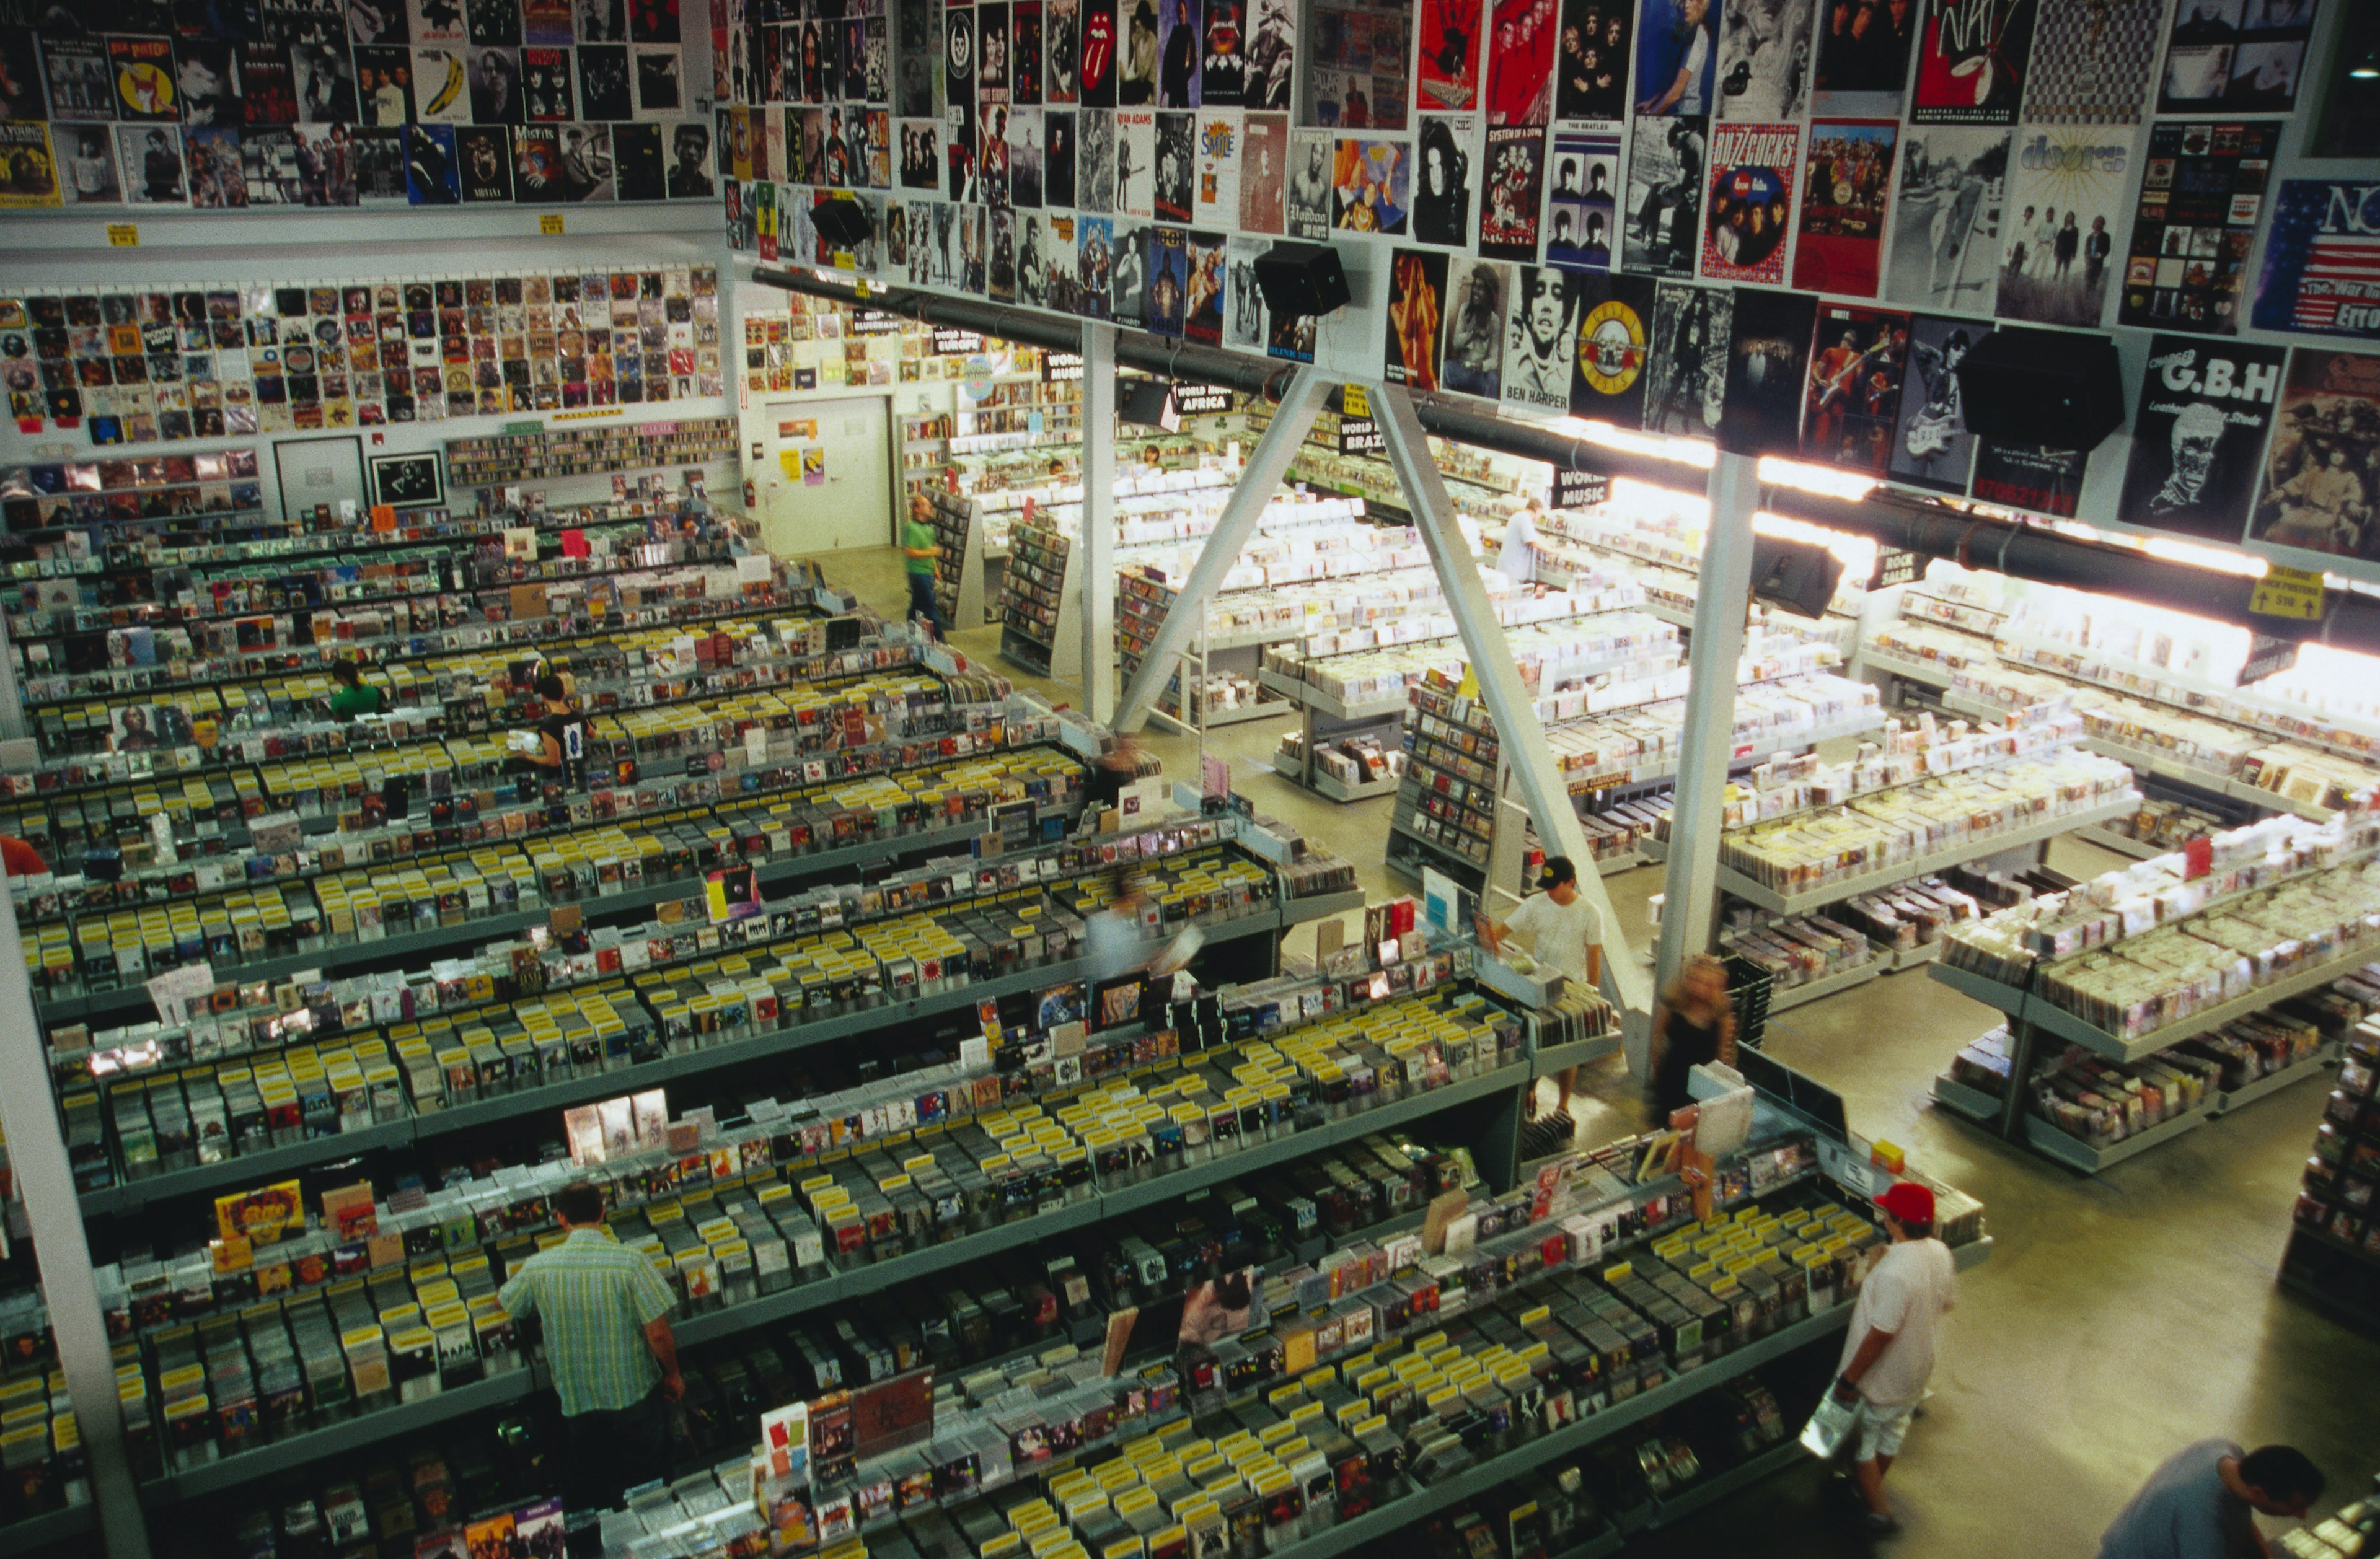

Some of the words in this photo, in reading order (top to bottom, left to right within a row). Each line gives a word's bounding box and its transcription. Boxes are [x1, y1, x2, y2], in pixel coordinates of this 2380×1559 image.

[1132, 113, 1152, 125] ADAMS
[514, 125, 555, 141] MISFITS
[1489, 128, 1514, 142] SYSTEM
[1514, 128, 1522, 138] OF
[1528, 127, 1543, 137] DOWN
[1713, 128, 1796, 170] BUZZCOCKS
[938, 339, 979, 352] EUROPE
[1269, 346, 1298, 359] BLINK
[1178, 387, 1205, 397] WORLD
[1507, 386, 1525, 402] BEN
[1528, 392, 1567, 410] HARPER
[1183, 395, 1225, 411] AFRICA
[1341, 423, 1372, 435] WORLD
[1562, 486, 1605, 506] MUSIC
[1885, 553, 1913, 570] ROCK
[1882, 568, 1913, 586] SALSA
